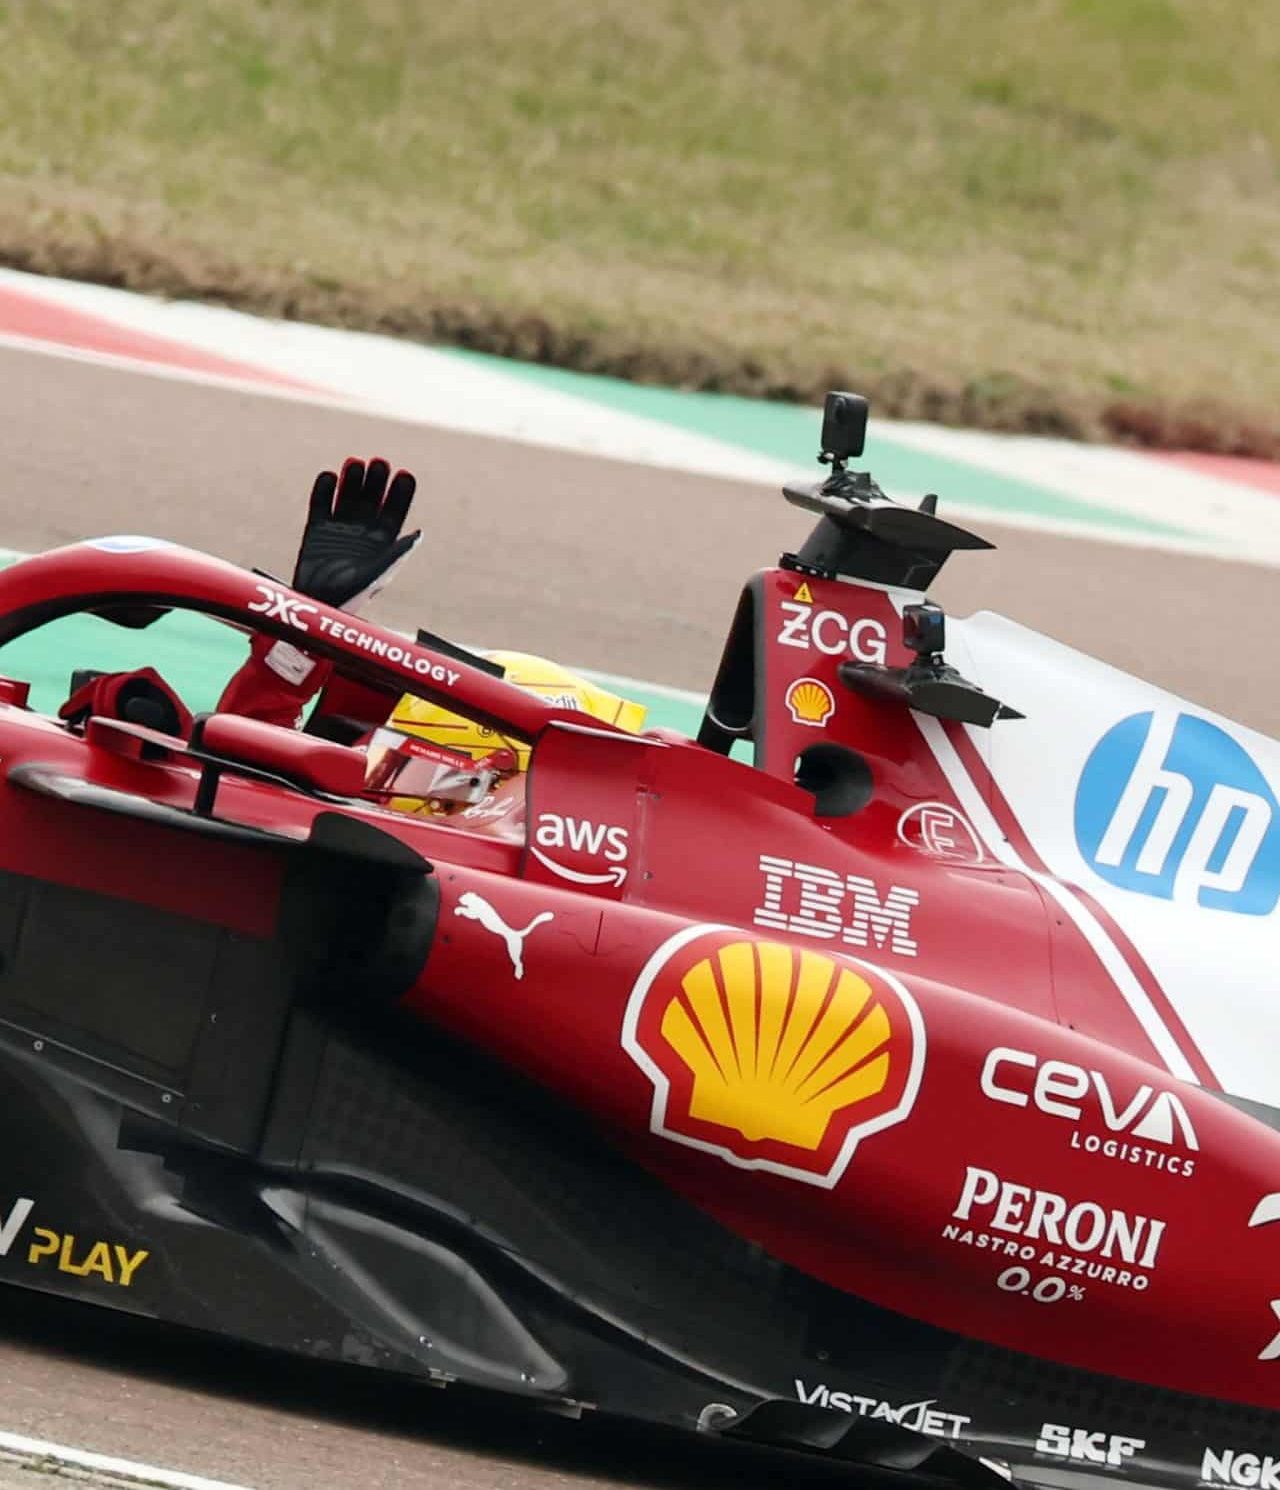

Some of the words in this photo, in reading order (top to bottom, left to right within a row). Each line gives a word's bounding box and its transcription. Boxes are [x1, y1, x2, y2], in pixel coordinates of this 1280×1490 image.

[319, 616, 462, 687] TECHNOLOGY
[777, 601, 888, 665] ZCG
[1093, 708, 1273, 903] hp
[535, 812, 630, 862] aws
[753, 854, 920, 957] IBM
[1070, 1130, 1197, 1177] LOGISTICS
[952, 1165, 1166, 1269] PERONI
[28, 1226, 150, 1287] PLAY
[941, 1224, 1035, 1261] NASTRO
[1039, 1249, 1150, 1292] AZZURRO
[996, 1265, 1085, 1304] 0.0%
[1035, 1422, 1147, 1466] SKF
[1200, 1446, 1280, 1490] NGK
